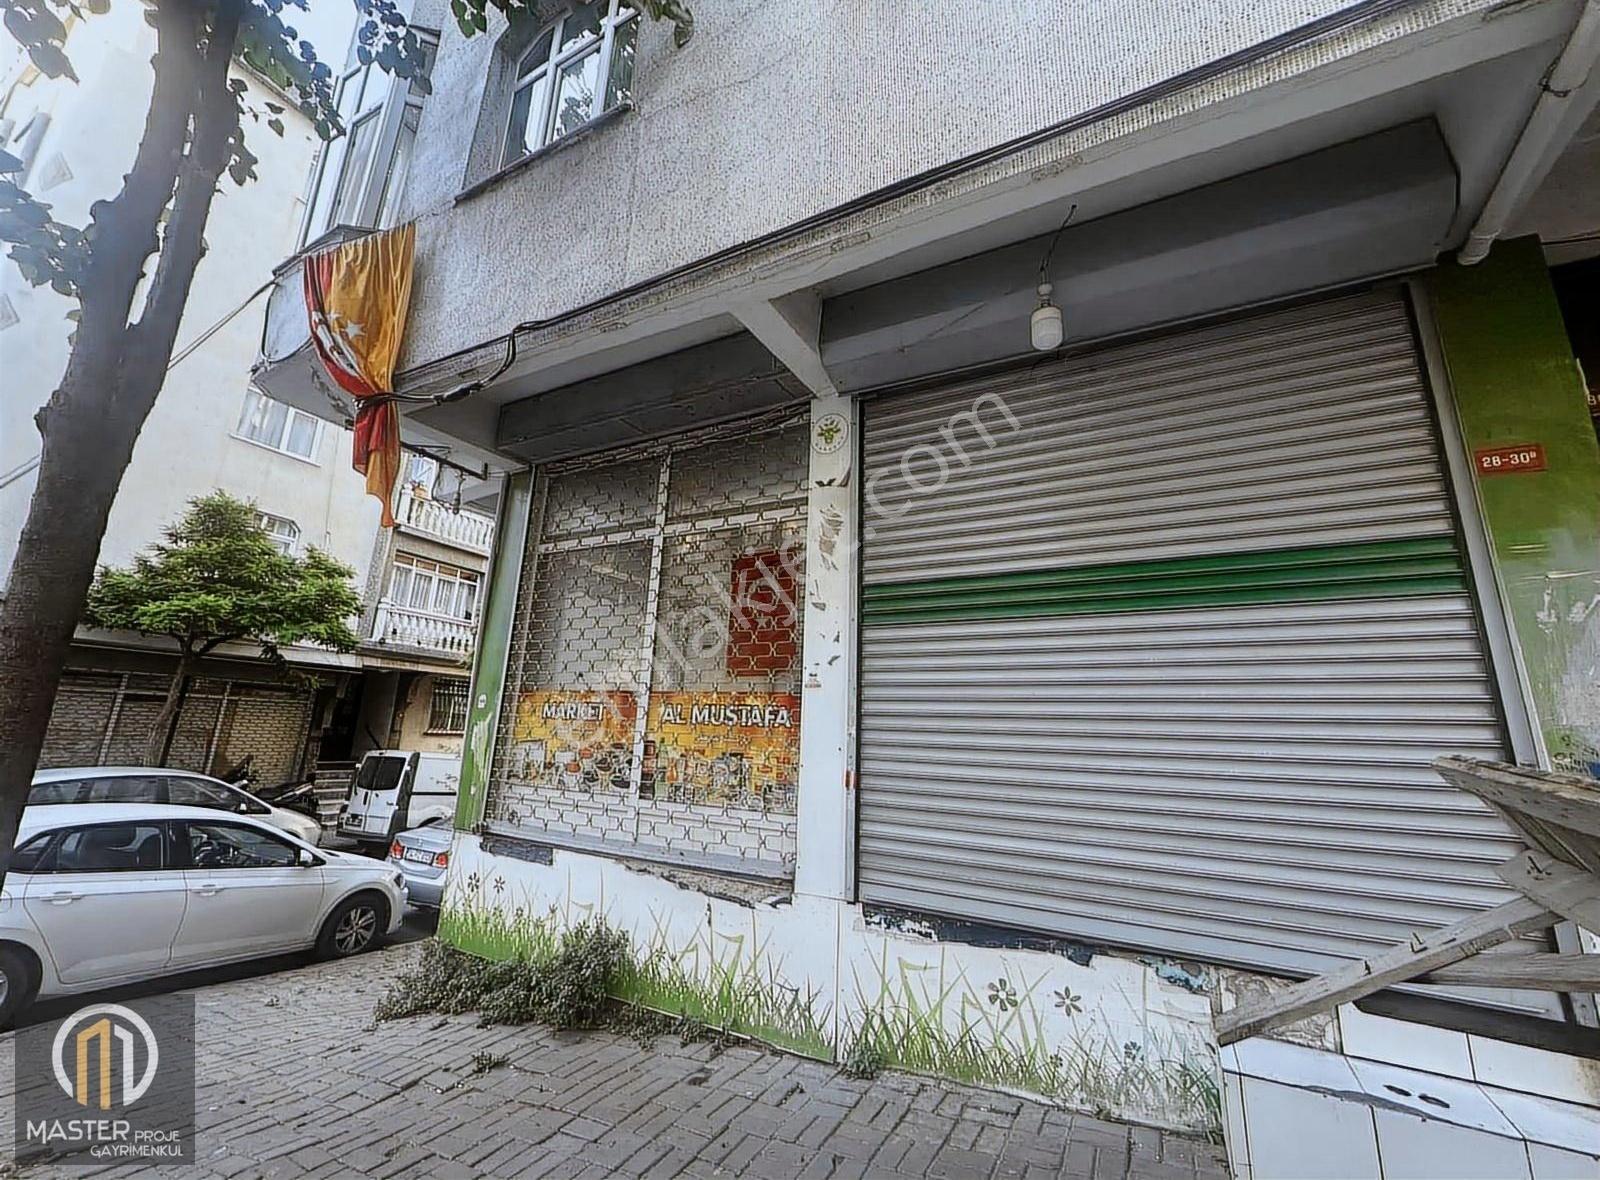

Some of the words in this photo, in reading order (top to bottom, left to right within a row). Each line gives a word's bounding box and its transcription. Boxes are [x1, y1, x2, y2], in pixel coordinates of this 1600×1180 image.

[541, 701, 606, 721] MARKET
[662, 703, 688, 725] AL
[691, 703, 792, 727] MUSTAFA
